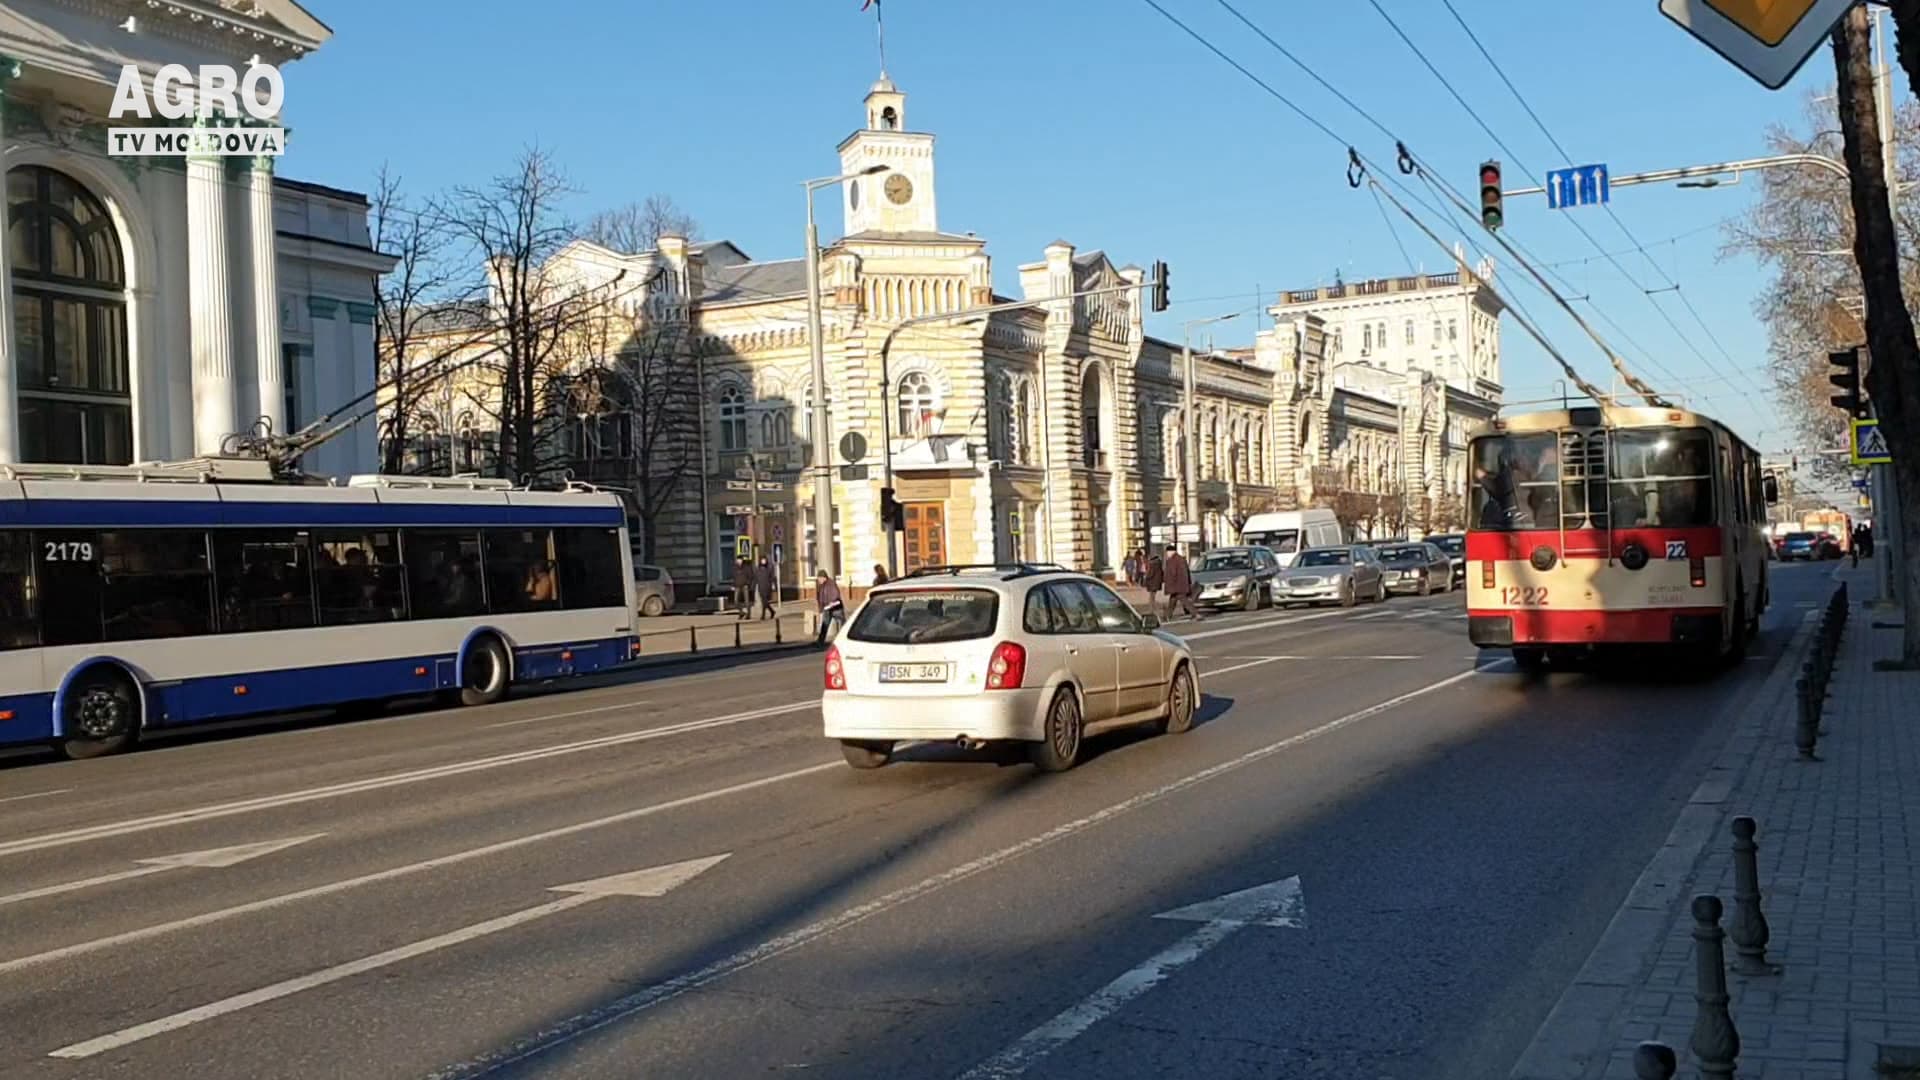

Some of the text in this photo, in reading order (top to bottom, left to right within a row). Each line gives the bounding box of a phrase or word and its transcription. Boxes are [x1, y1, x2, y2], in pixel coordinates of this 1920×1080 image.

[45, 542, 92, 560] 2179
[1667, 543, 1687, 560] 22
[1501, 586, 1549, 605] 1222
[889, 666, 941, 678] BSN 349
